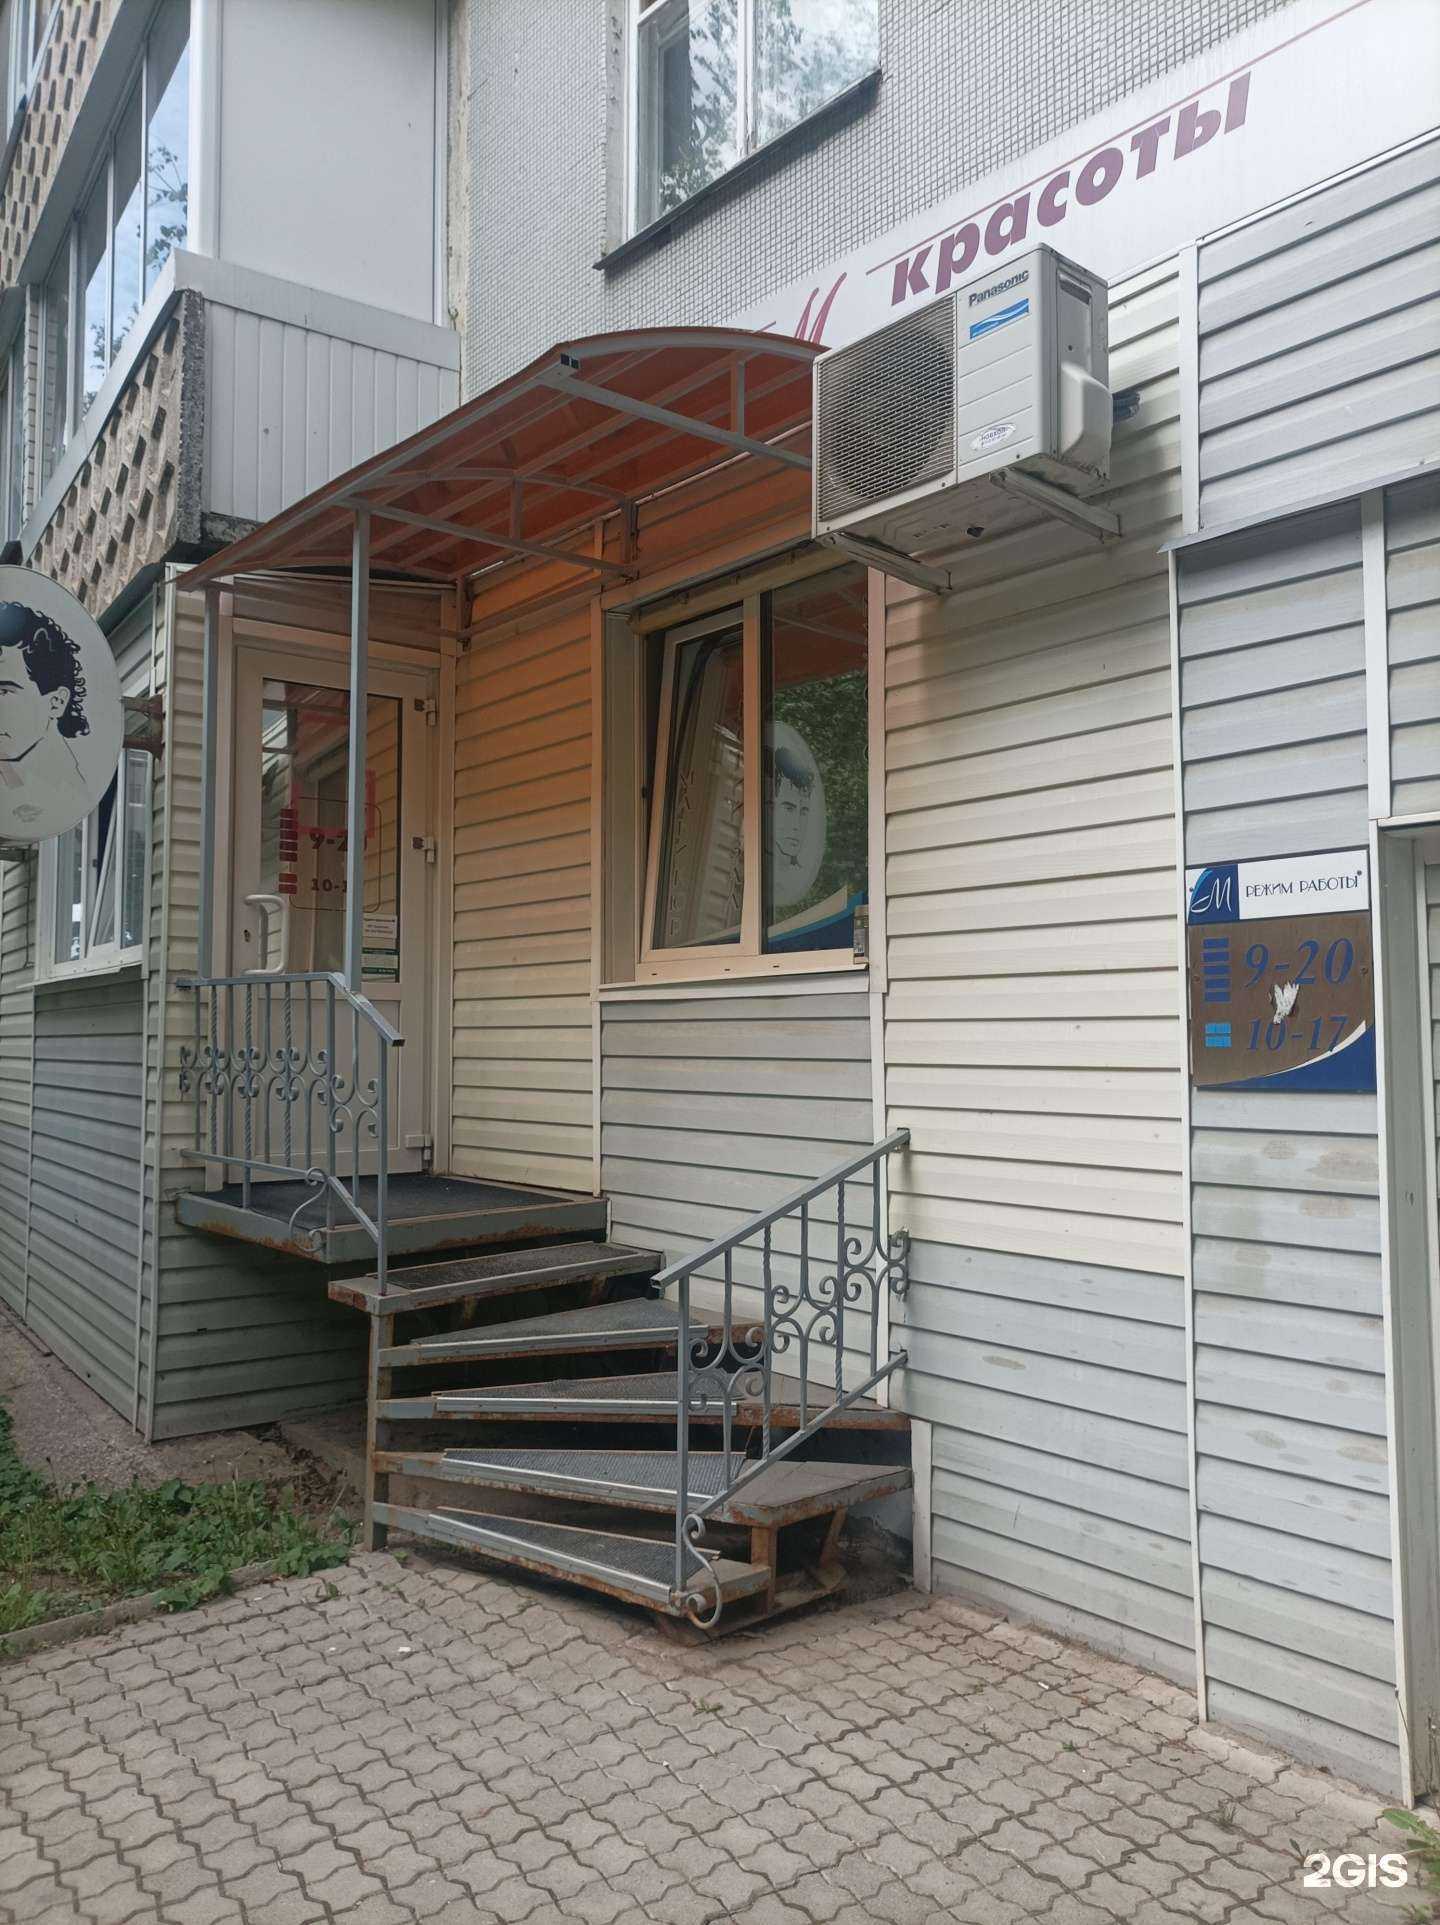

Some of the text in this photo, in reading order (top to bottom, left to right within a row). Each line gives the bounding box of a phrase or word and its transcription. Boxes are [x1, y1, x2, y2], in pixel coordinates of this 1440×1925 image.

[892, 73, 1251, 305] красоты
[968, 270, 1030, 306] Panasonic
[1246, 875, 1358, 897] РЕЖИМ РАБОТЫ
[1244, 938, 1354, 988] 9-20
[1246, 1016, 1347, 1053] 10-17
